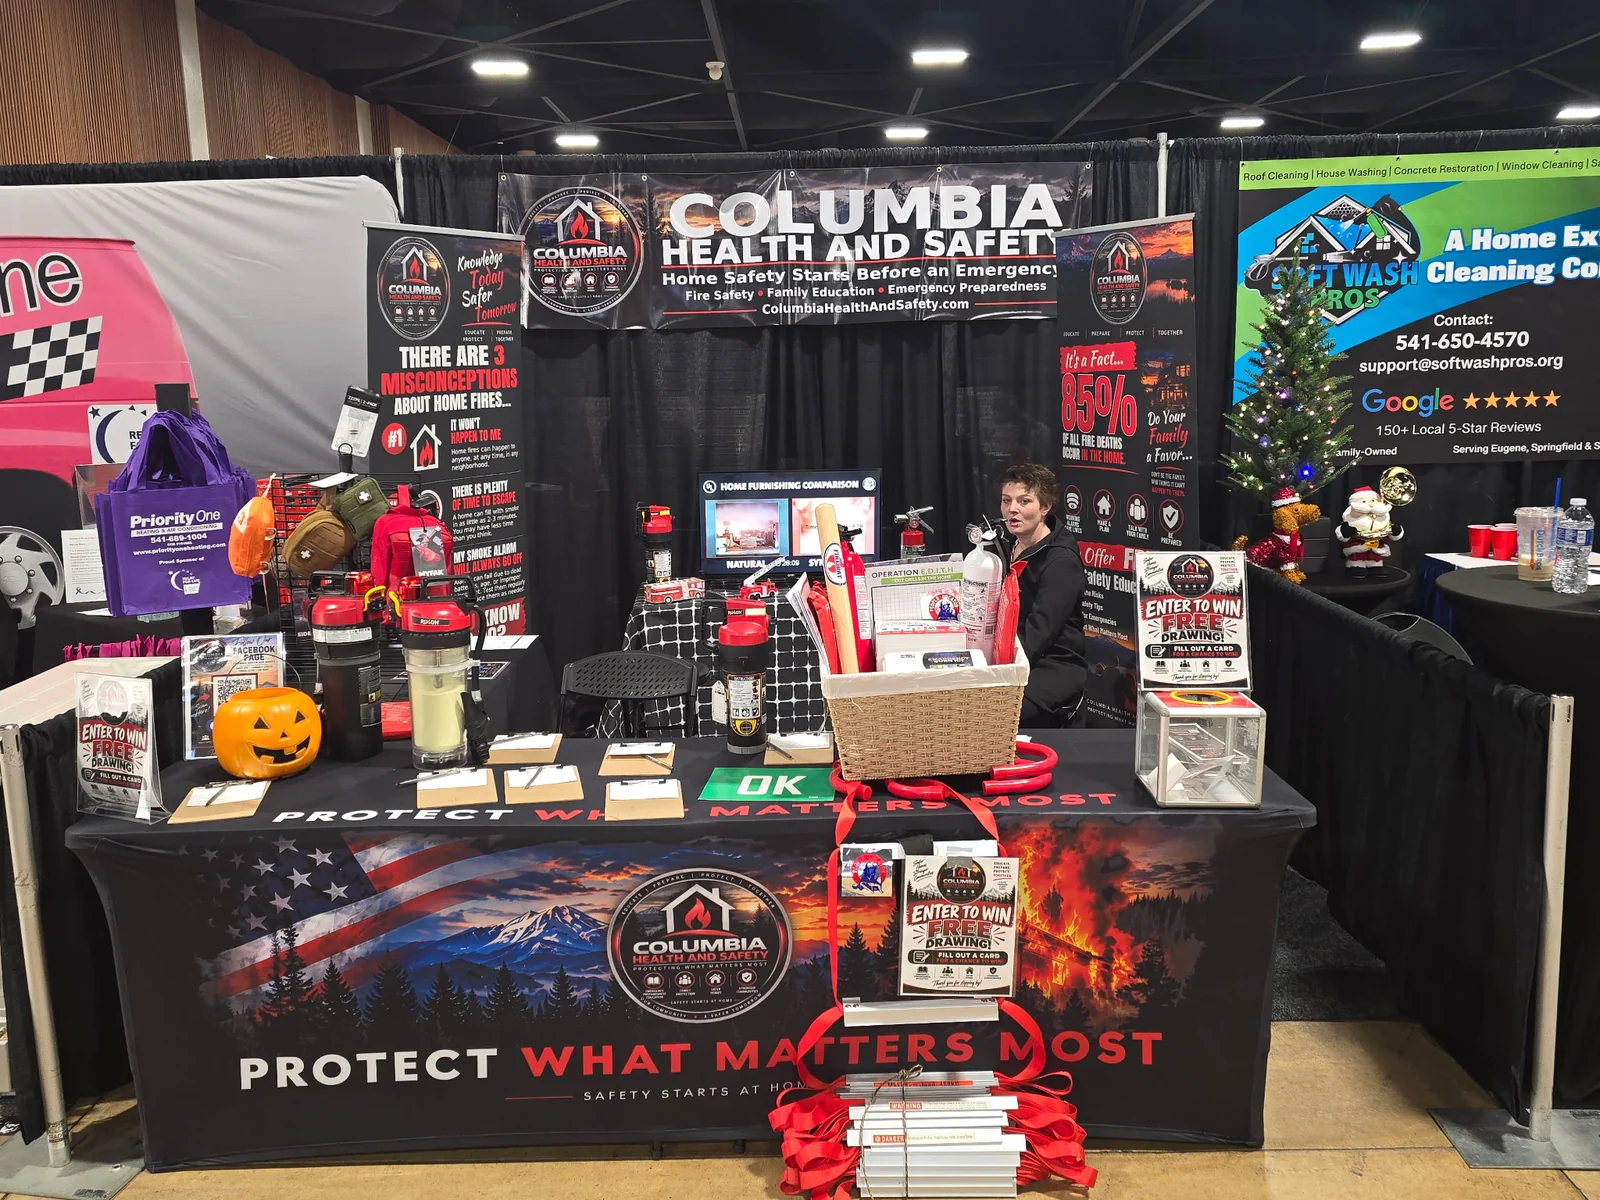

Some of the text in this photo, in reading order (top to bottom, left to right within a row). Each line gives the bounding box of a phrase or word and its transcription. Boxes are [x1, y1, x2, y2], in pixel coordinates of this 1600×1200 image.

[1243, 171, 1266, 182] Roof
[1268, 170, 1309, 181] Cleaning
[1316, 169, 1346, 178] House
[1348, 167, 1387, 178] Washing
[1394, 166, 1437, 175] Concrete
[1439, 163, 1494, 173] Restoration
[1502, 161, 1540, 171] Window
[1541, 160, 1584, 170] Cleaning
[670, 183, 1063, 238] COLUMBIA
[661, 235, 813, 265] HEALTH
[825, 232, 910, 262] AND
[1444, 229, 1465, 252] A
[1471, 228, 1557, 251] Home
[457, 248, 503, 272] Knowledge
[533, 245, 628, 260] COLUMBIA
[470, 266, 504, 290] Today
[662, 264, 1057, 286] Home Safety Starts Before an Emergency
[1097, 274, 1140, 285] COLUMBIA
[1342, 261, 1420, 288] WASH
[1426, 258, 1556, 285] Cleaning
[388, 284, 442, 296] COLUMBIA
[462, 286, 493, 308] Safer
[685, 281, 1047, 302] Fire Safety Family Education Emergency Preparedness
[475, 301, 517, 323] Tomorrow
[762, 299, 969, 314] ColumbiaHealthAndSafety.com
[1433, 314, 1493, 327] Contact:
[1395, 331, 1530, 350] 541-650-4570
[399, 344, 505, 368] THERE ARE 3
[1065, 350, 1124, 369] It's a Fact...
[1359, 355, 1564, 374] support@softwashpros.org
[381, 367, 518, 395] MISCONCEPTIONS
[394, 391, 512, 415] ABOUT HOME FIRES...
[1061, 372, 1138, 437] 85%
[1361, 388, 1454, 418] Google
[1147, 409, 1186, 426] Do Your
[388, 428, 403, 448] #1
[451, 429, 501, 444] HAPPEN TO ME
[1149, 423, 1189, 449] Family
[1376, 421, 1542, 436] 150+ Local 5-Star Reviews
[1062, 432, 1123, 450] OF ALL FIRE DEATHS
[1062, 446, 1126, 465] OCCUR IN THE HOME.
[1146, 447, 1193, 463] a Favor...
[451, 461, 490, 472] neighborhood.
[452, 480, 509, 498] THERE IS PLENTY
[720, 480, 860, 492] HOME FURNISHING COMPARISON
[452, 491, 516, 511] OF TIME TO ESCAPE
[130, 509, 221, 529] Priority One
[177, 524, 218, 532] CONDITIONING
[150, 532, 207, 544] 541-689-1004
[1160, 537, 1182, 546] PREPARED
[453, 542, 517, 564] MY SMOKE ALARM
[1084, 547, 1115, 569] Offer
[454, 552, 523, 575] WILL ALWAYS GO OFF
[726, 559, 767, 569] NATURAL
[871, 569, 919, 579] OPERATION
[485, 602, 520, 627] KNOW
[1145, 598, 1241, 618] ENTER TO WIN
[1161, 612, 1224, 633] FREE
[1161, 630, 1225, 643] DRAWING!
[232, 645, 275, 654] FACEBOOK
[243, 653, 265, 661] PAGE
[82, 723, 147, 747] ENTER TO WIN
[736, 775, 807, 796] OK
[621, 872, 775, 915] EDUCATE PREPARE PROTECT TOGETHER
[911, 903, 1012, 925] ENTER TO WIN
[926, 920, 993, 940] FREE
[633, 936, 767, 955] COLUMBIA
[925, 937, 992, 950] DRAWING!
[632, 950, 769, 965] HEALTH AND SAFETY
[239, 1030, 1163, 1090] PROTECT WHAT MATTERS MOST
[583, 1080, 808, 1101] SAFETY STARTS AT HOM
[881, 1135, 904, 1143] DANGER
